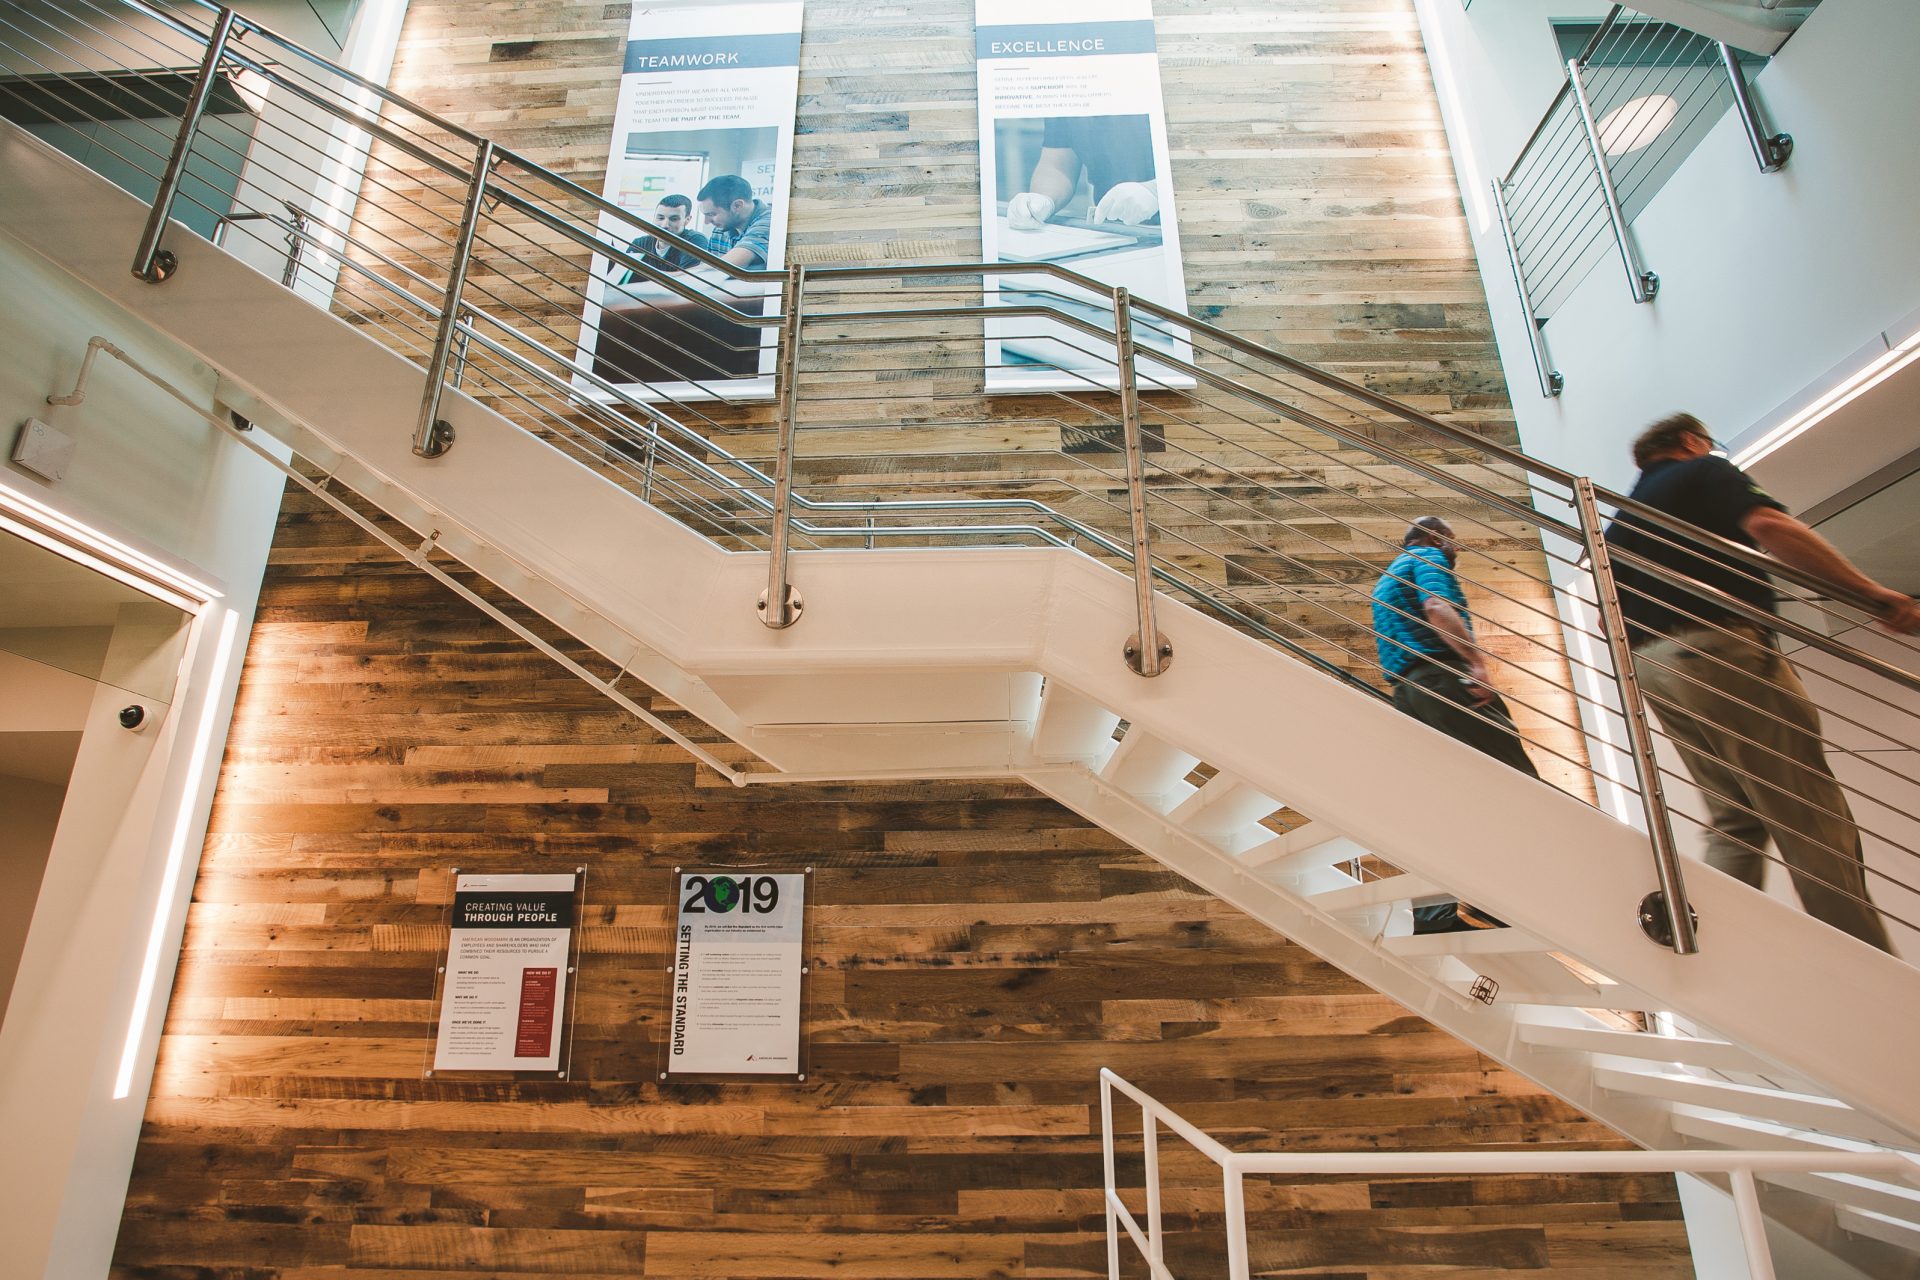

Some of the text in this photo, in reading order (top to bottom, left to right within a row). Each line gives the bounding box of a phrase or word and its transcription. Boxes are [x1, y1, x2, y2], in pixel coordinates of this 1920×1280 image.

[991, 39, 1105, 54] EXCELLENCE
[638, 52, 739, 68] TEAMWORK
[682, 876, 779, 914] 2019
[465, 902, 546, 911] CREATING VALUE
[464, 913, 558, 922] THROUGH PEOPLE
[673, 925, 692, 1056] SETTING THE STANDARD
